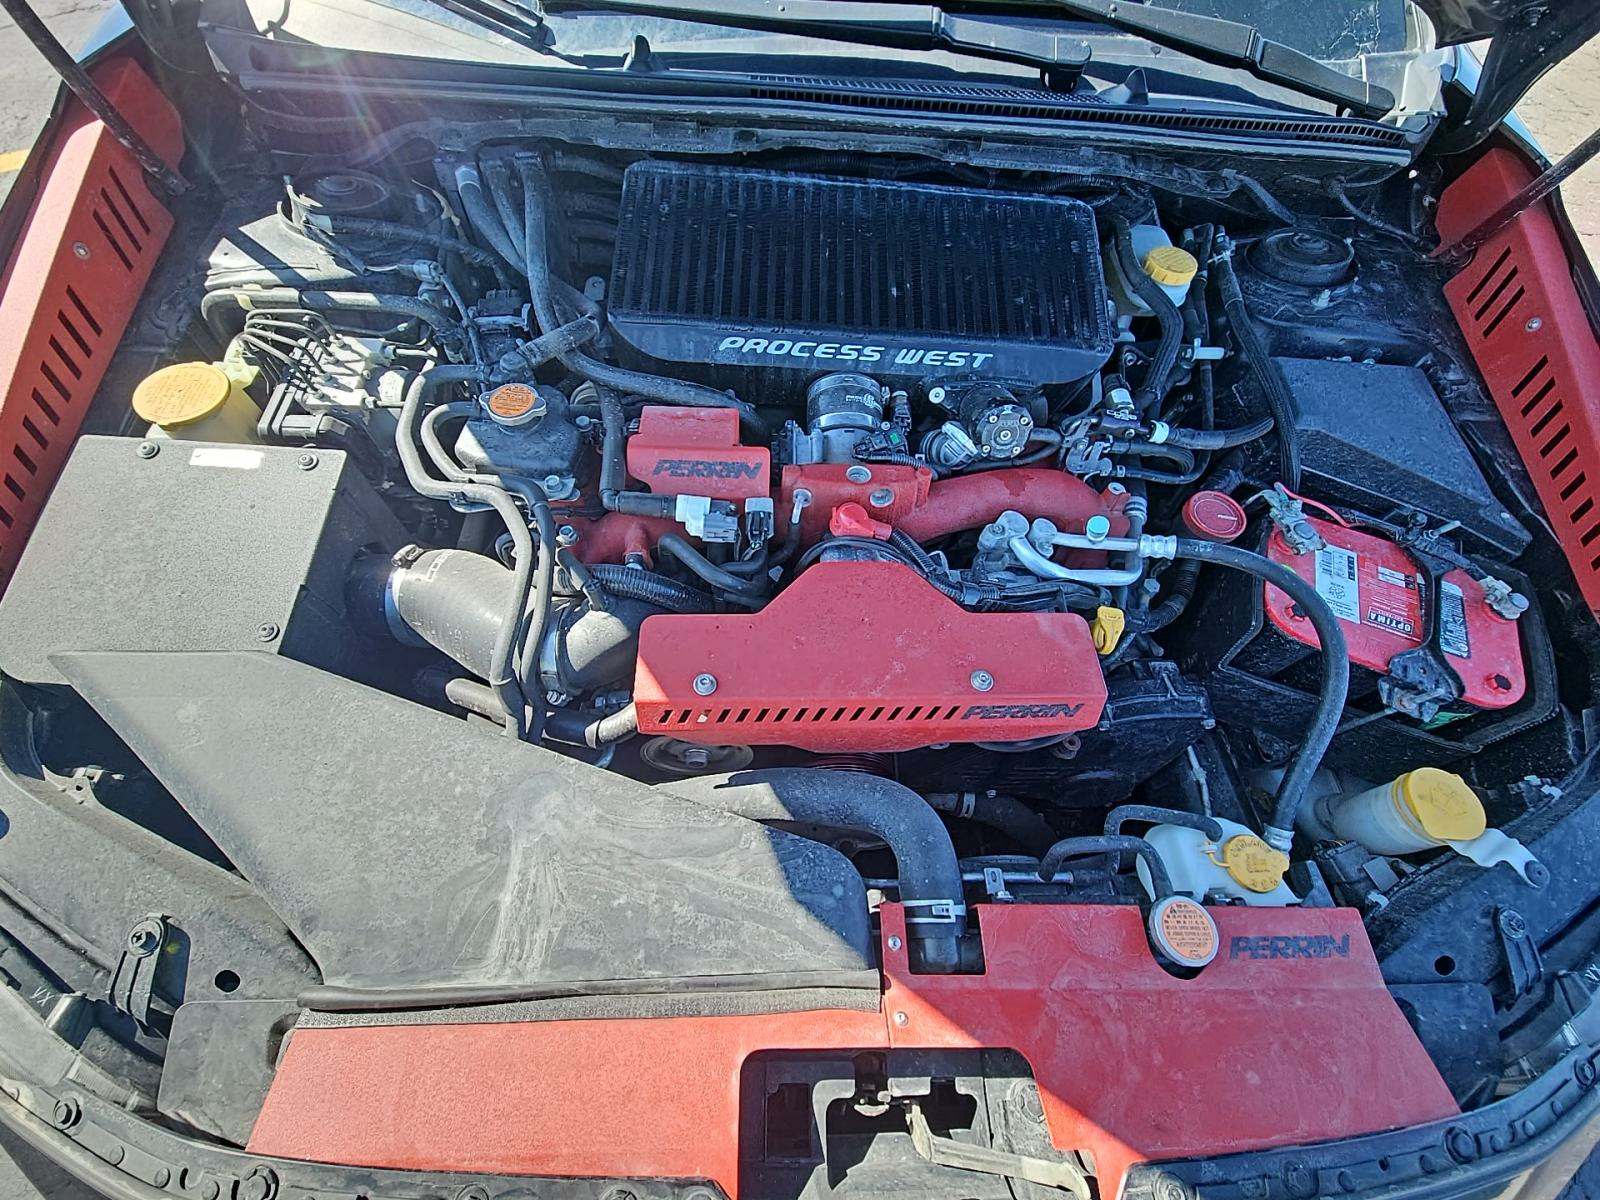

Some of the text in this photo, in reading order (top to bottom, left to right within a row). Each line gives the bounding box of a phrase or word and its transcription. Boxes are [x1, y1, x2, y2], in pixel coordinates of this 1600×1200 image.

[718, 336, 993, 369] PROCESS WEST
[652, 459, 763, 480] PERRIN
[1369, 611, 1412, 632] OPTIMA
[960, 703, 1085, 720] PERRIN
[1229, 933, 1350, 960] PERRIN
